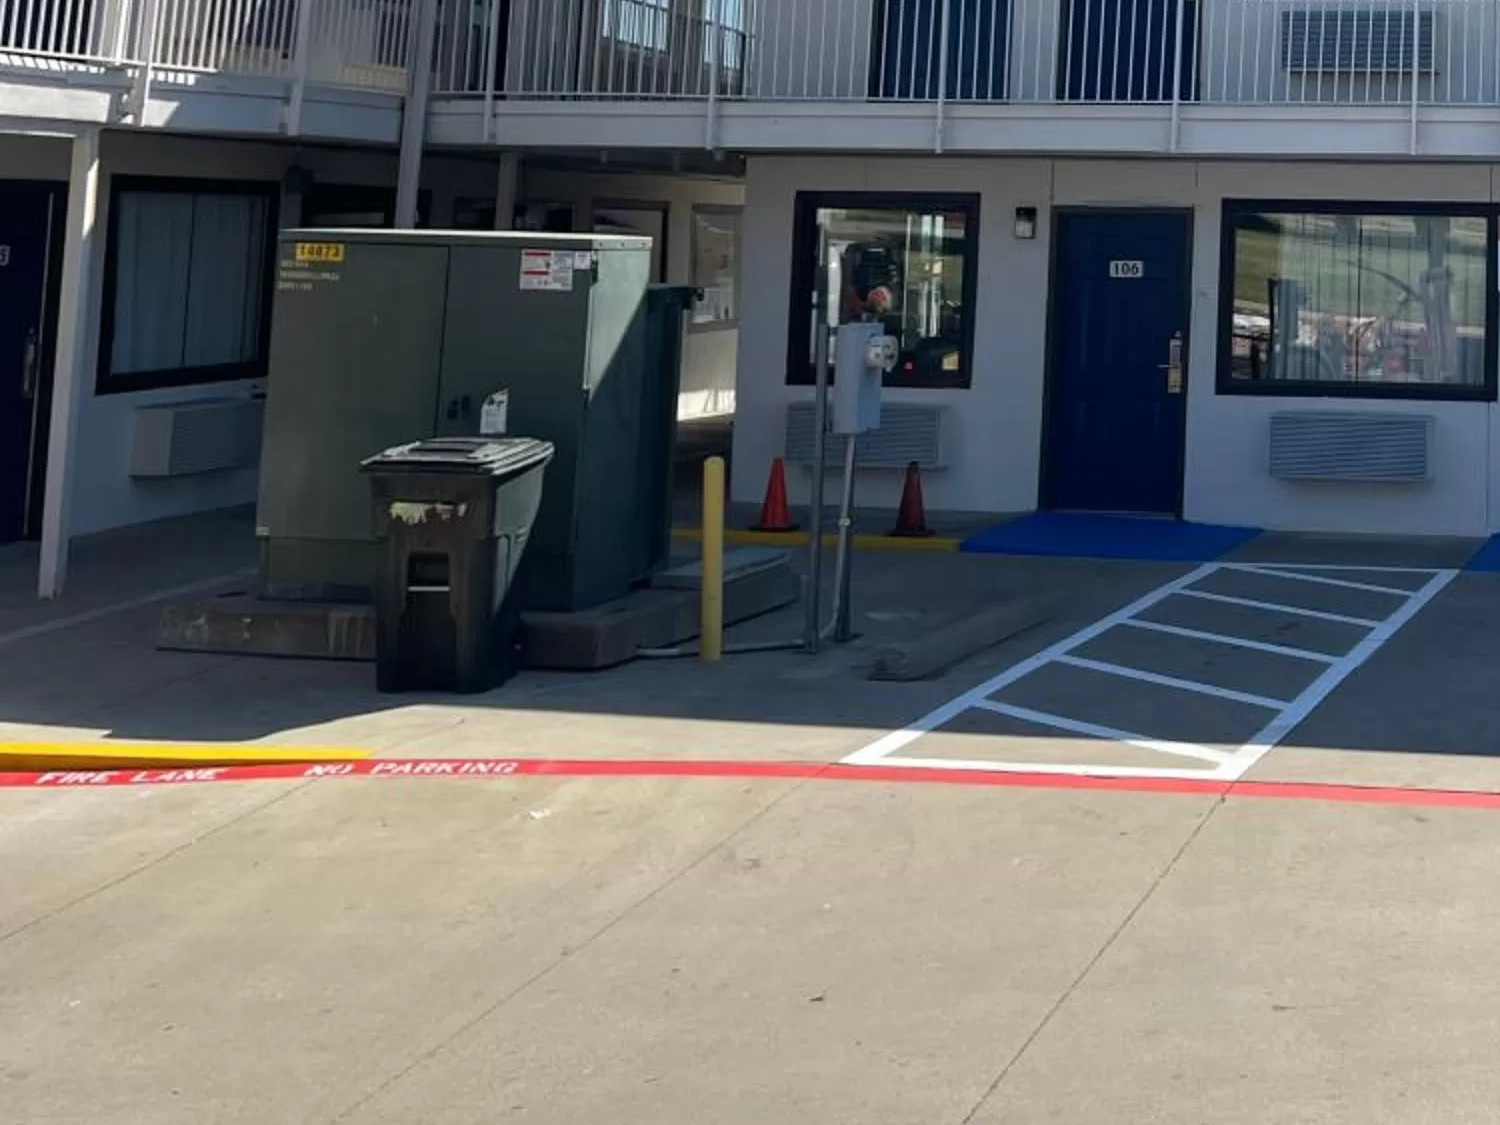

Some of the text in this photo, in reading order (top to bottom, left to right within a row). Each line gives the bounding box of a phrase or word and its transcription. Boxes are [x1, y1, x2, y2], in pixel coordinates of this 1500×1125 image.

[1113, 262, 1139, 276] 106
[35, 766, 230, 784] FIRE LANE
[303, 761, 520, 778] NO PARKING
